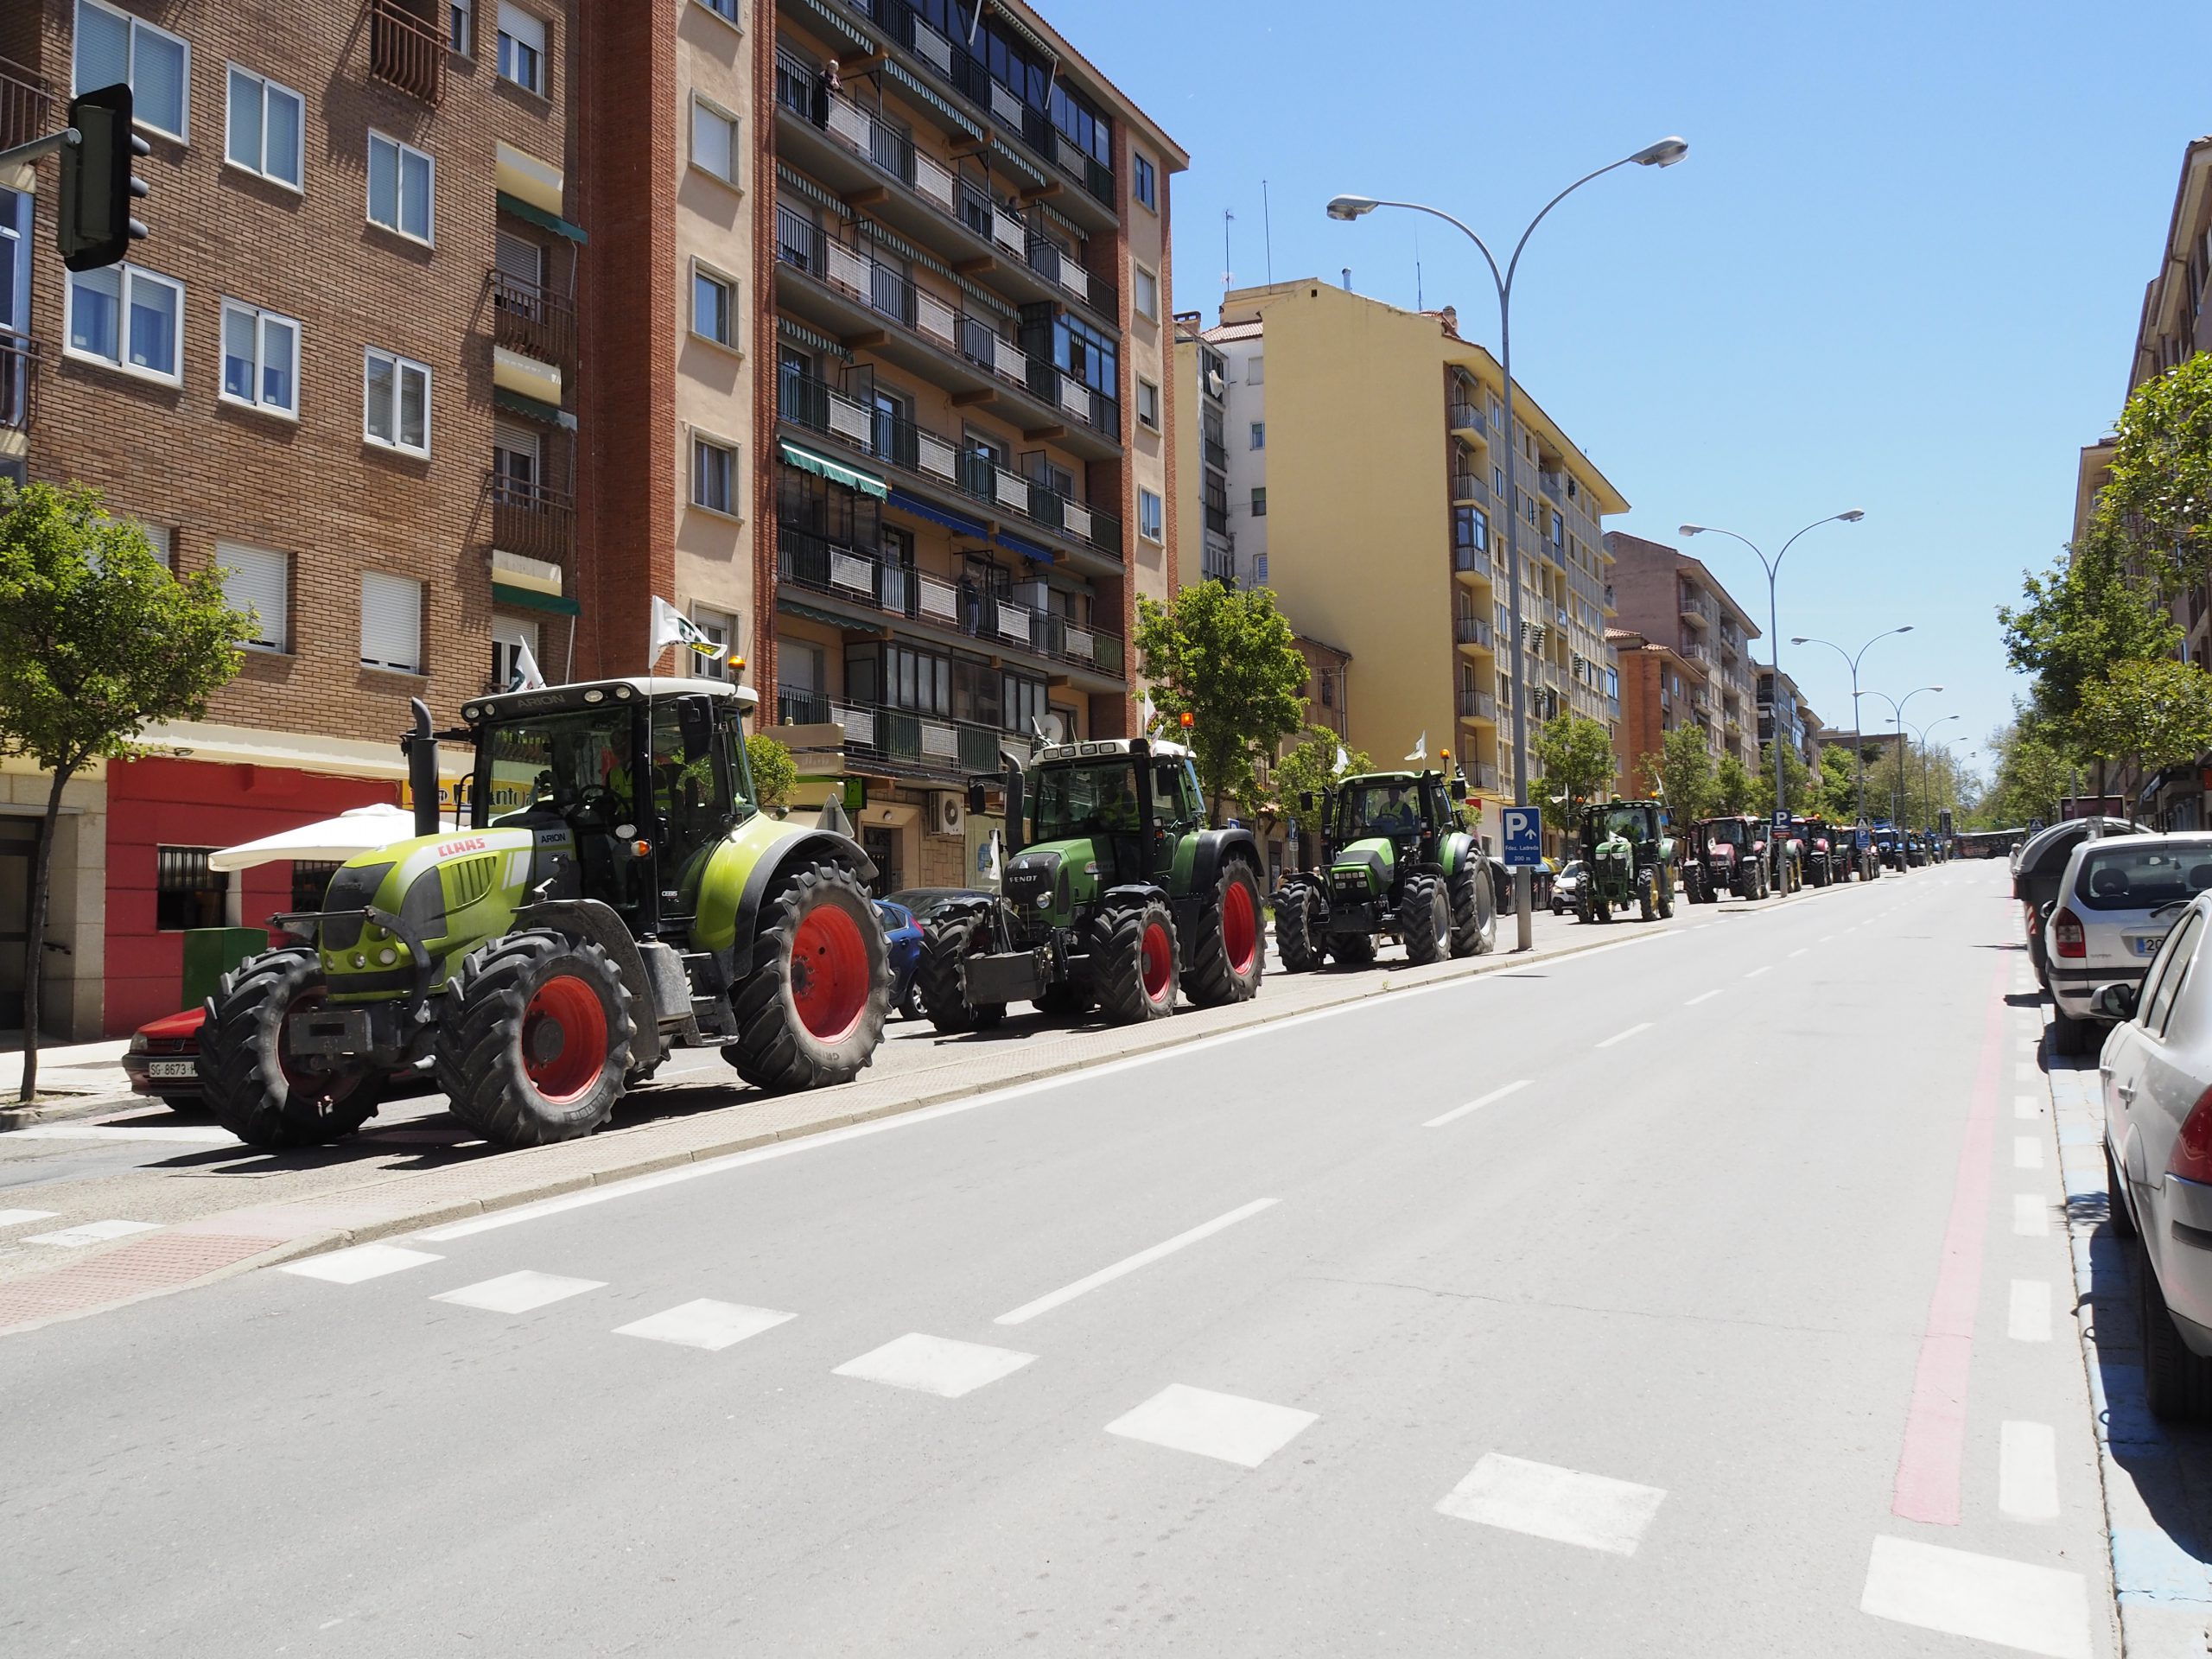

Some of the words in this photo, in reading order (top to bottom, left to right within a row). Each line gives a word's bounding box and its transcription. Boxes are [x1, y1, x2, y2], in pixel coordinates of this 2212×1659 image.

[1776, 812, 1787, 825] P
[1506, 813, 1528, 840] P
[541, 833, 566, 843] ARION
[438, 838, 486, 857] CLAAS
[2146, 939, 2163, 951] 20
